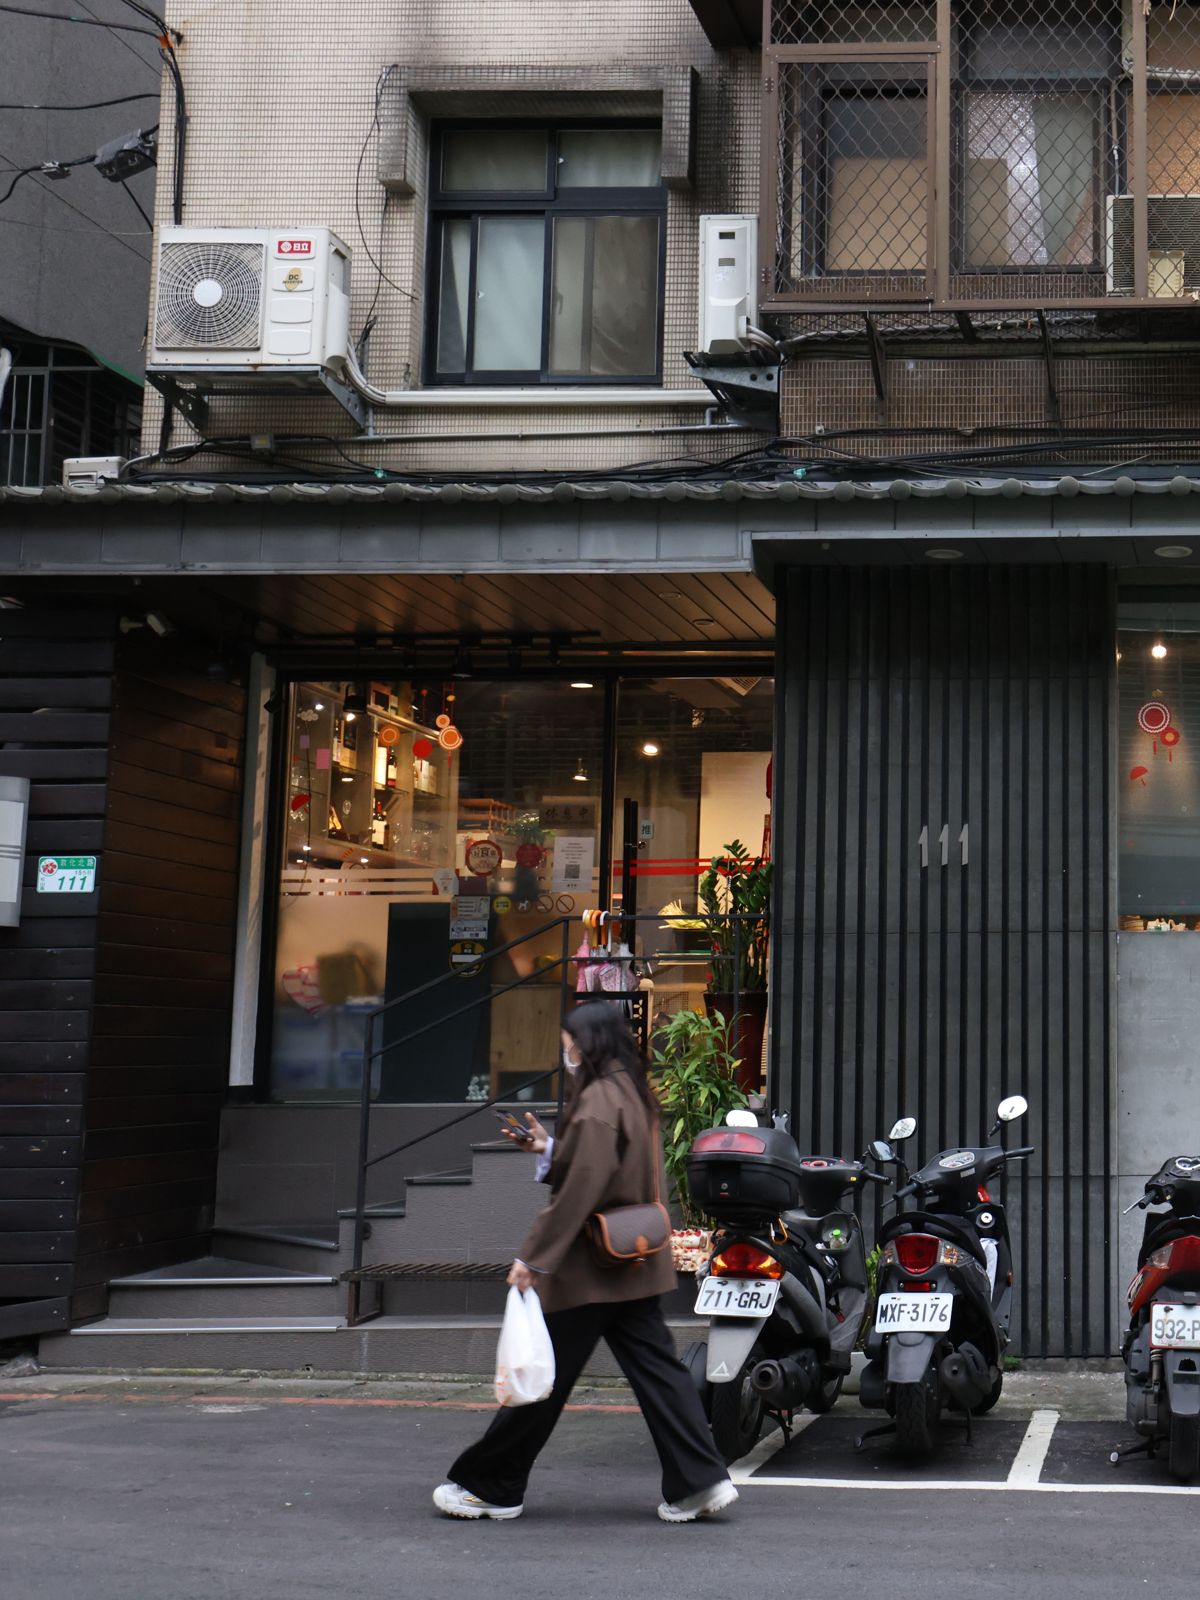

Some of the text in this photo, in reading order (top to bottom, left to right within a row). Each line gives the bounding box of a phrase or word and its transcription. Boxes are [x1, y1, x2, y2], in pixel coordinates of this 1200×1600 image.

[293, 243, 309, 251] 日立
[917, 824, 969, 868] 111
[58, 876, 87, 890] 111
